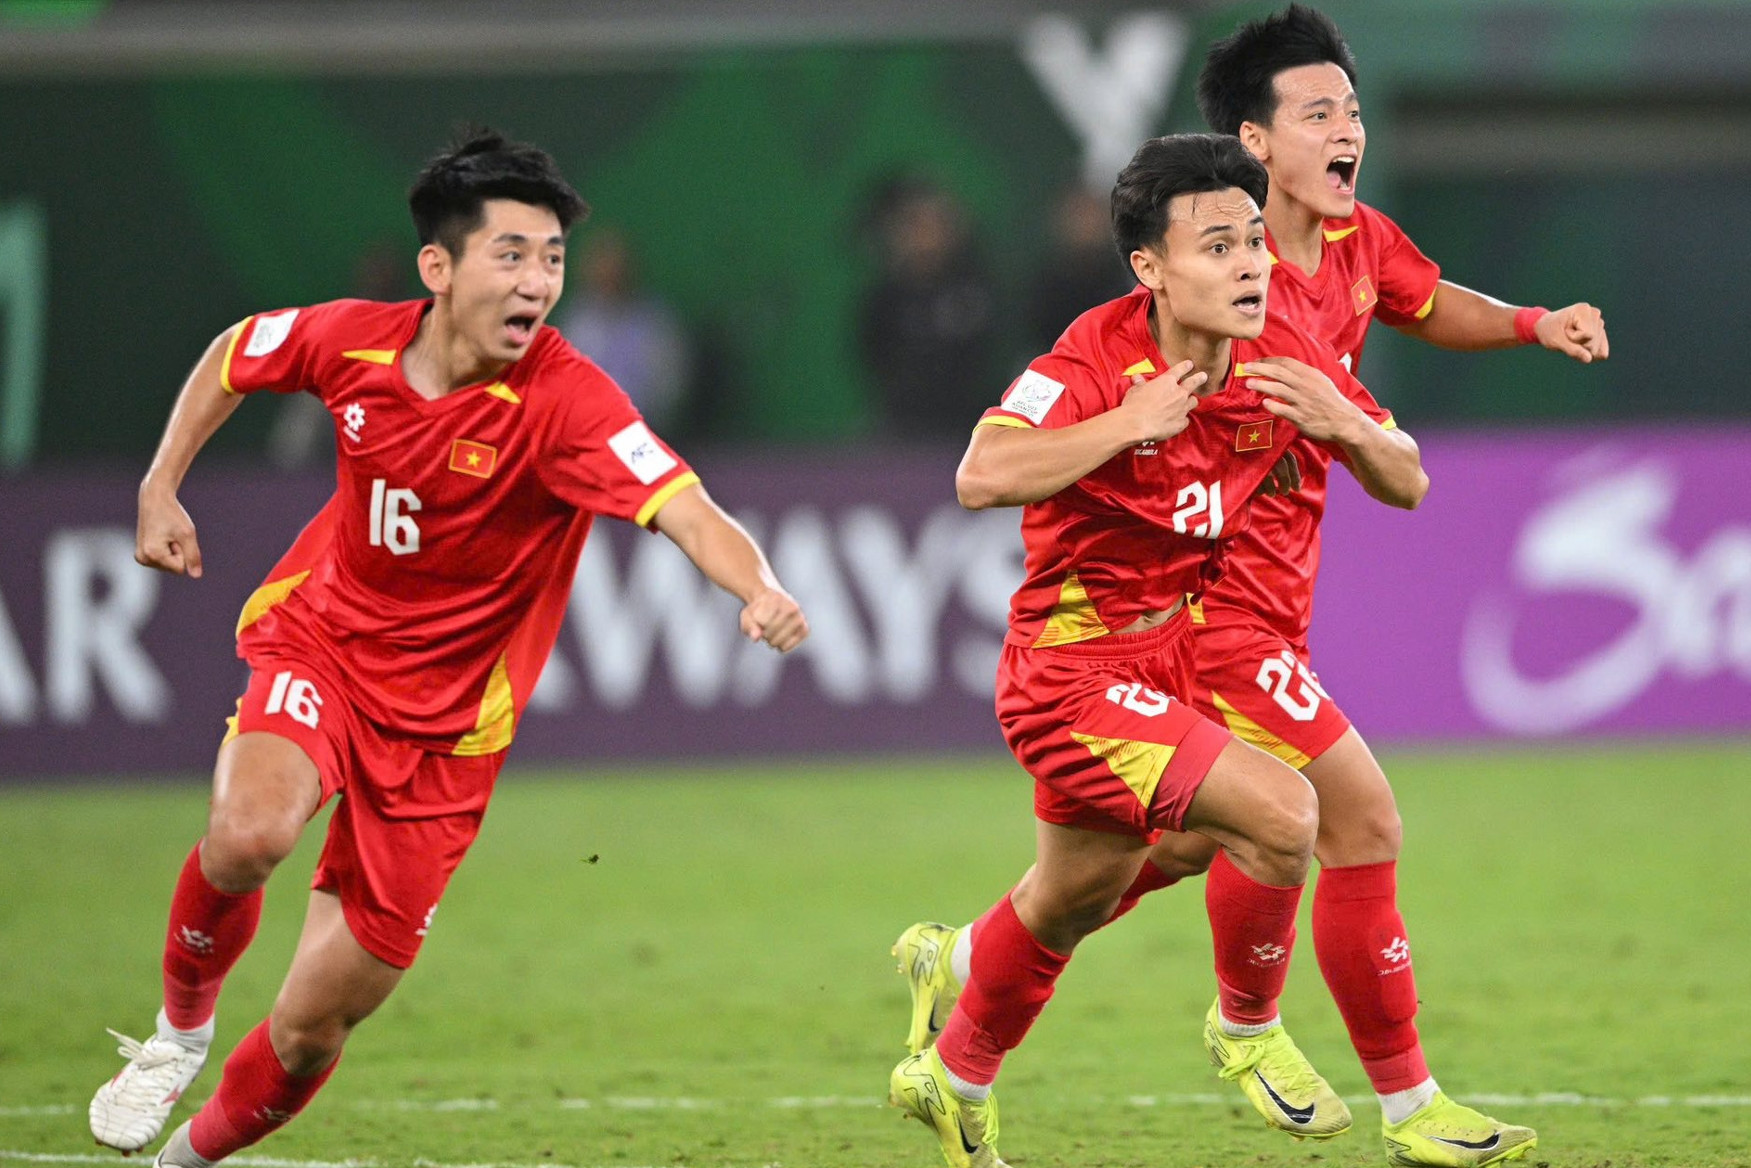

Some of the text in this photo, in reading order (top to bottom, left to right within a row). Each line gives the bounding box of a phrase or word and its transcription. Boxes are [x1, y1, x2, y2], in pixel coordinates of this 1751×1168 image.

[369, 478, 422, 556] 16
[1172, 480, 1224, 539] 21
[528, 506, 1024, 712] WAYS
[264, 670, 324, 731] 16
[1105, 682, 1178, 717] 2
